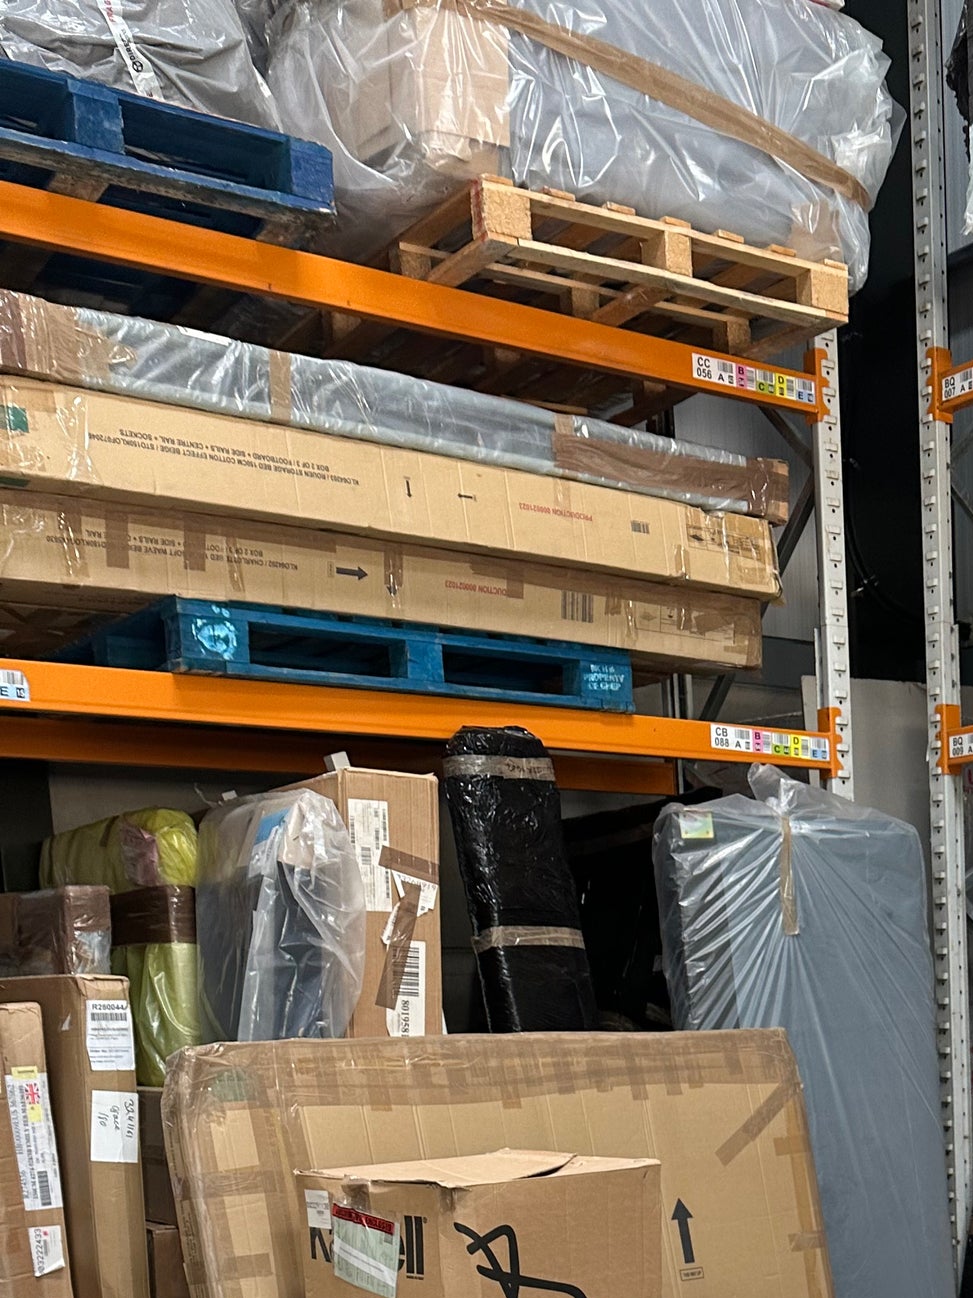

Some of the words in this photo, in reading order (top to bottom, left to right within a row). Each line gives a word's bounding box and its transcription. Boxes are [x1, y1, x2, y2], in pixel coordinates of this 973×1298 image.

[697, 357, 710, 368] CC
[696, 367, 712, 379] 056
[718, 374, 724, 382] A
[738, 366, 744, 375] B
[778, 376, 784, 384] D
[944, 376, 956, 388] BQ
[758, 382, 764, 391] C
[798, 391, 803, 400] E
[944, 386, 956, 398] 007
[960, 385, 965, 393] A
[119, 429, 152, 440] SOCKETS
[159, 435, 176, 444] RAIL
[176, 438, 204, 449] CENTRE
[160, 447, 180, 455] BEIGE
[210, 445, 229, 454] RAILS
[231, 448, 246, 457] SIDE
[183, 451, 207, 460] EFFECT
[209, 455, 236, 464] COTTON
[253, 453, 292, 466] FOOTBOARD
[259, 463, 272, 471] BED
[273, 465, 303, 476] STORAGE
[551, 506, 593, 522] PRODUCTION
[138, 535, 159, 545] RAILS
[161, 538, 176, 546] SIDE
[715, 727, 728, 737] CB
[754, 732, 760, 740] B
[714, 737, 730, 748] 088
[735, 740, 741, 749] A
[793, 737, 799, 745] D
[952, 737, 963, 746] BQ
[774, 745, 780, 753] C
[812, 749, 818, 758] E
